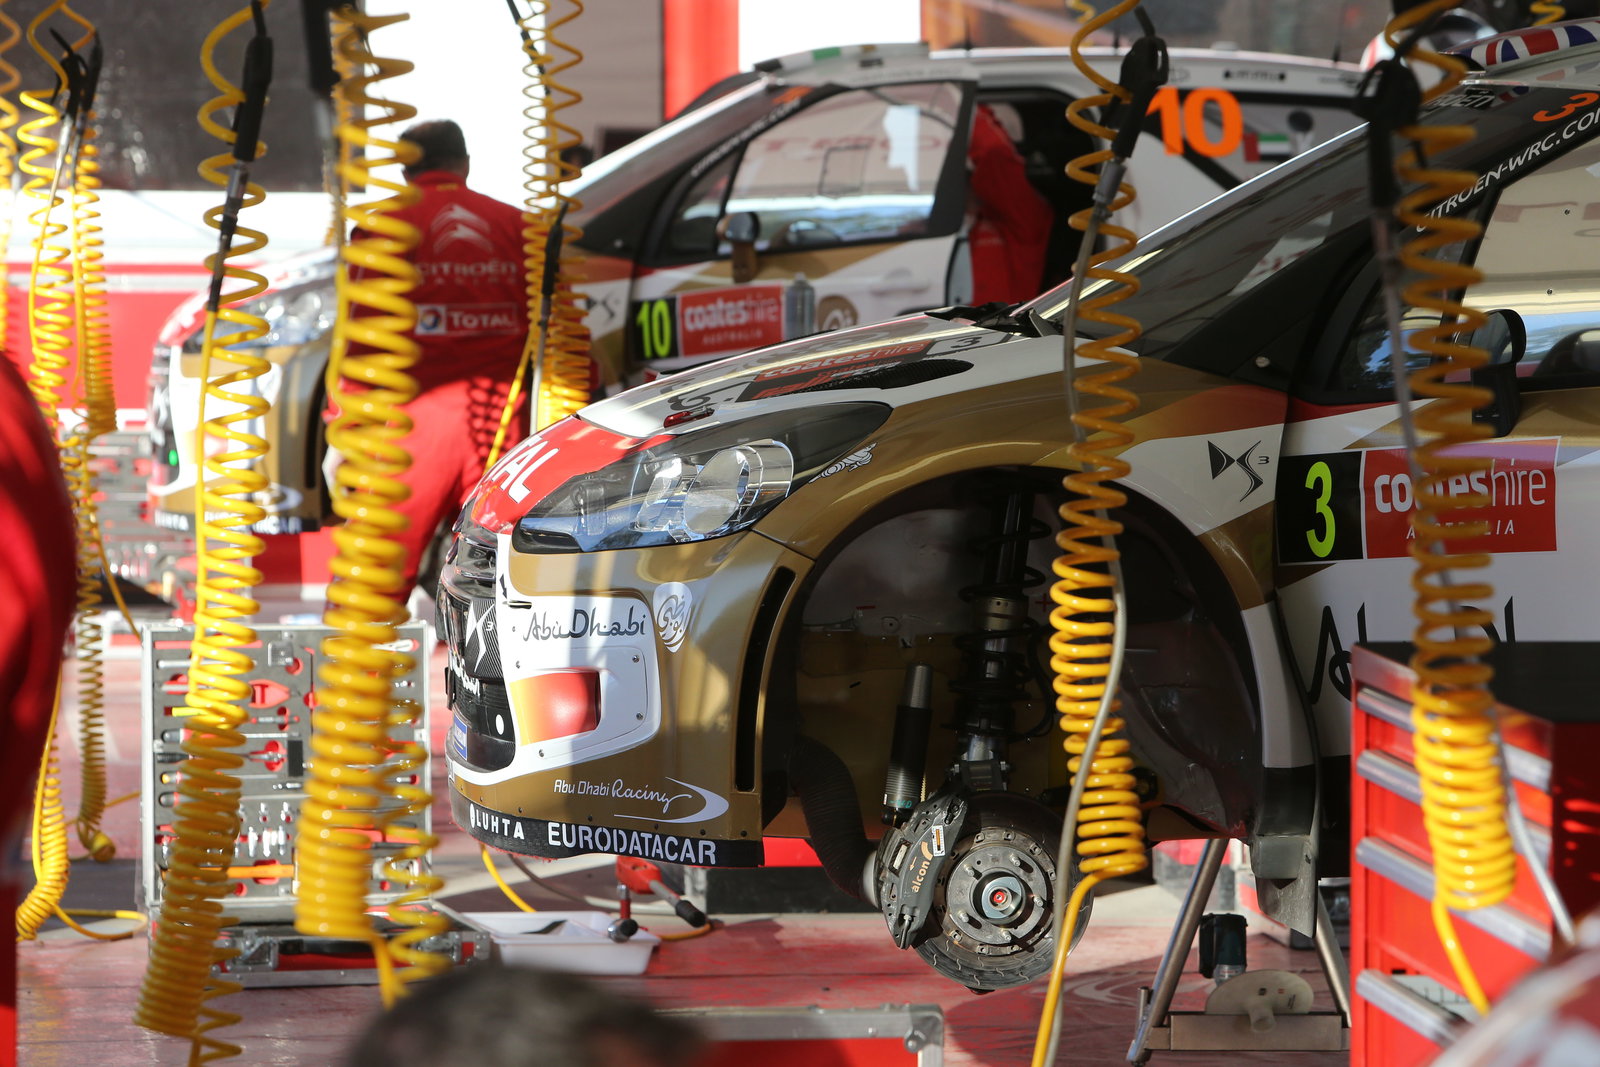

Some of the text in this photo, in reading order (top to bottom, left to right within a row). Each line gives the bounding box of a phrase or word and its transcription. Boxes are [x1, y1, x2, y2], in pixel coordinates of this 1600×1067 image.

[1146, 85, 1243, 158] 10
[1533, 92, 1599, 122] 3
[449, 311, 513, 329] TOTAL
[637, 299, 672, 358] 10
[1305, 457, 1547, 558] 3 coeshire
[553, 779, 693, 813] Abu Dhabi Racing
[475, 809, 717, 866] LUHTA EURODATACAR
[911, 860, 931, 893] alcon
